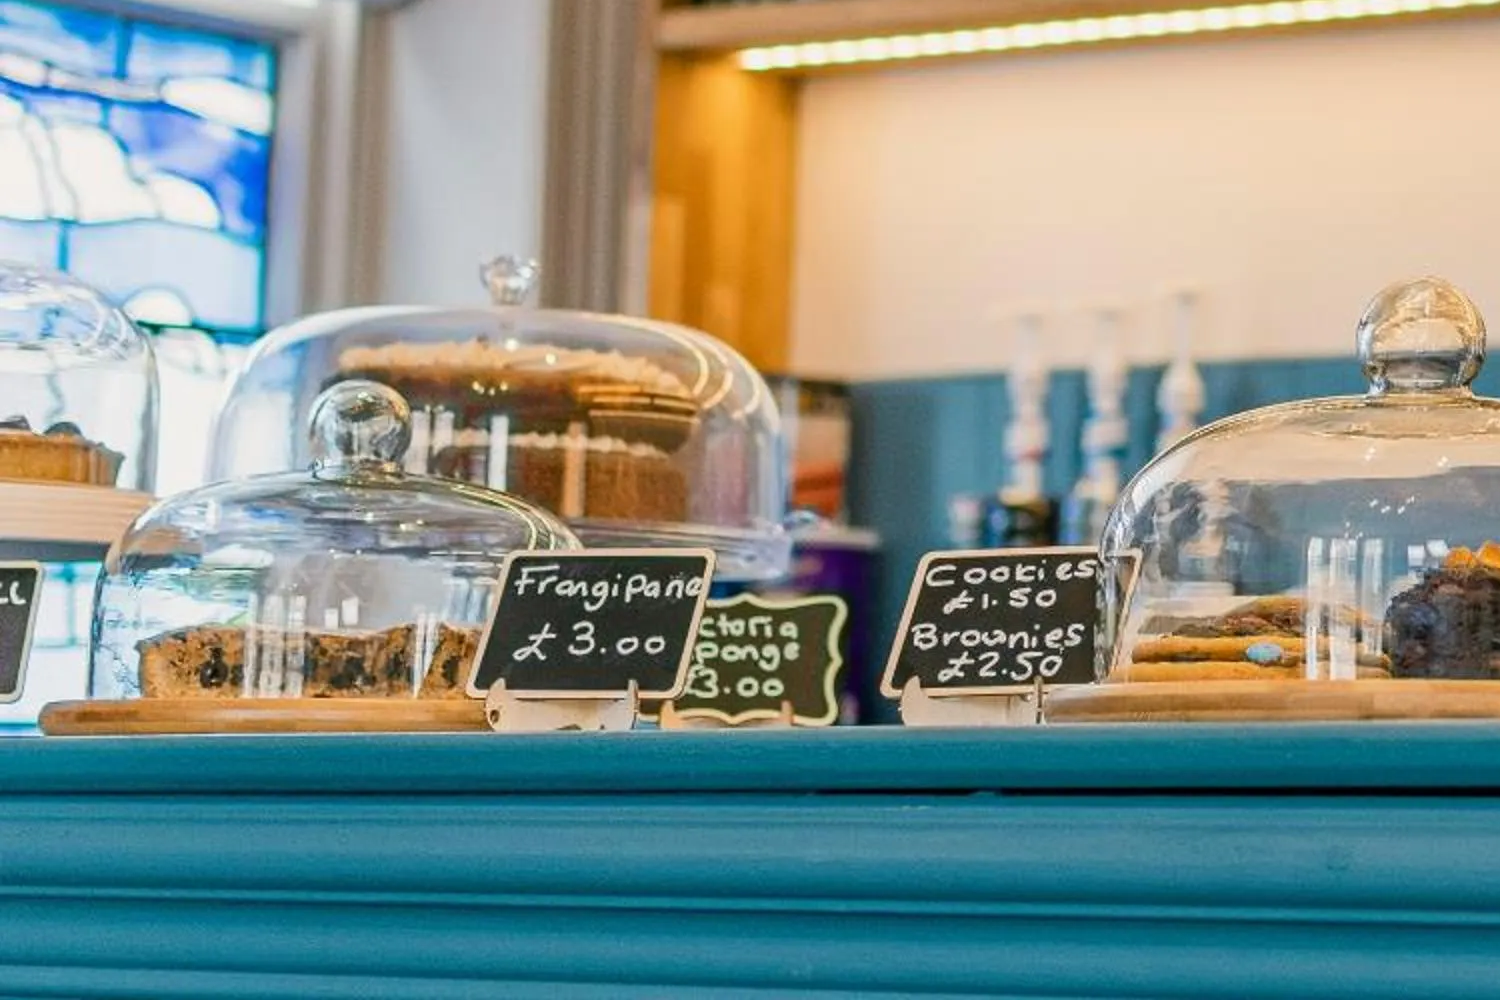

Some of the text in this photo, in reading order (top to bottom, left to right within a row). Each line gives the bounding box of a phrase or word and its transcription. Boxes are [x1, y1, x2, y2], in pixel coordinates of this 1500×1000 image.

[926, 559, 1097, 587] Cookies
[943, 587, 1057, 614] £1.50
[699, 613, 799, 638] ctoria
[911, 623, 1085, 650] Brownies
[692, 641, 800, 671] ponge
[938, 651, 1063, 682] £2.50
